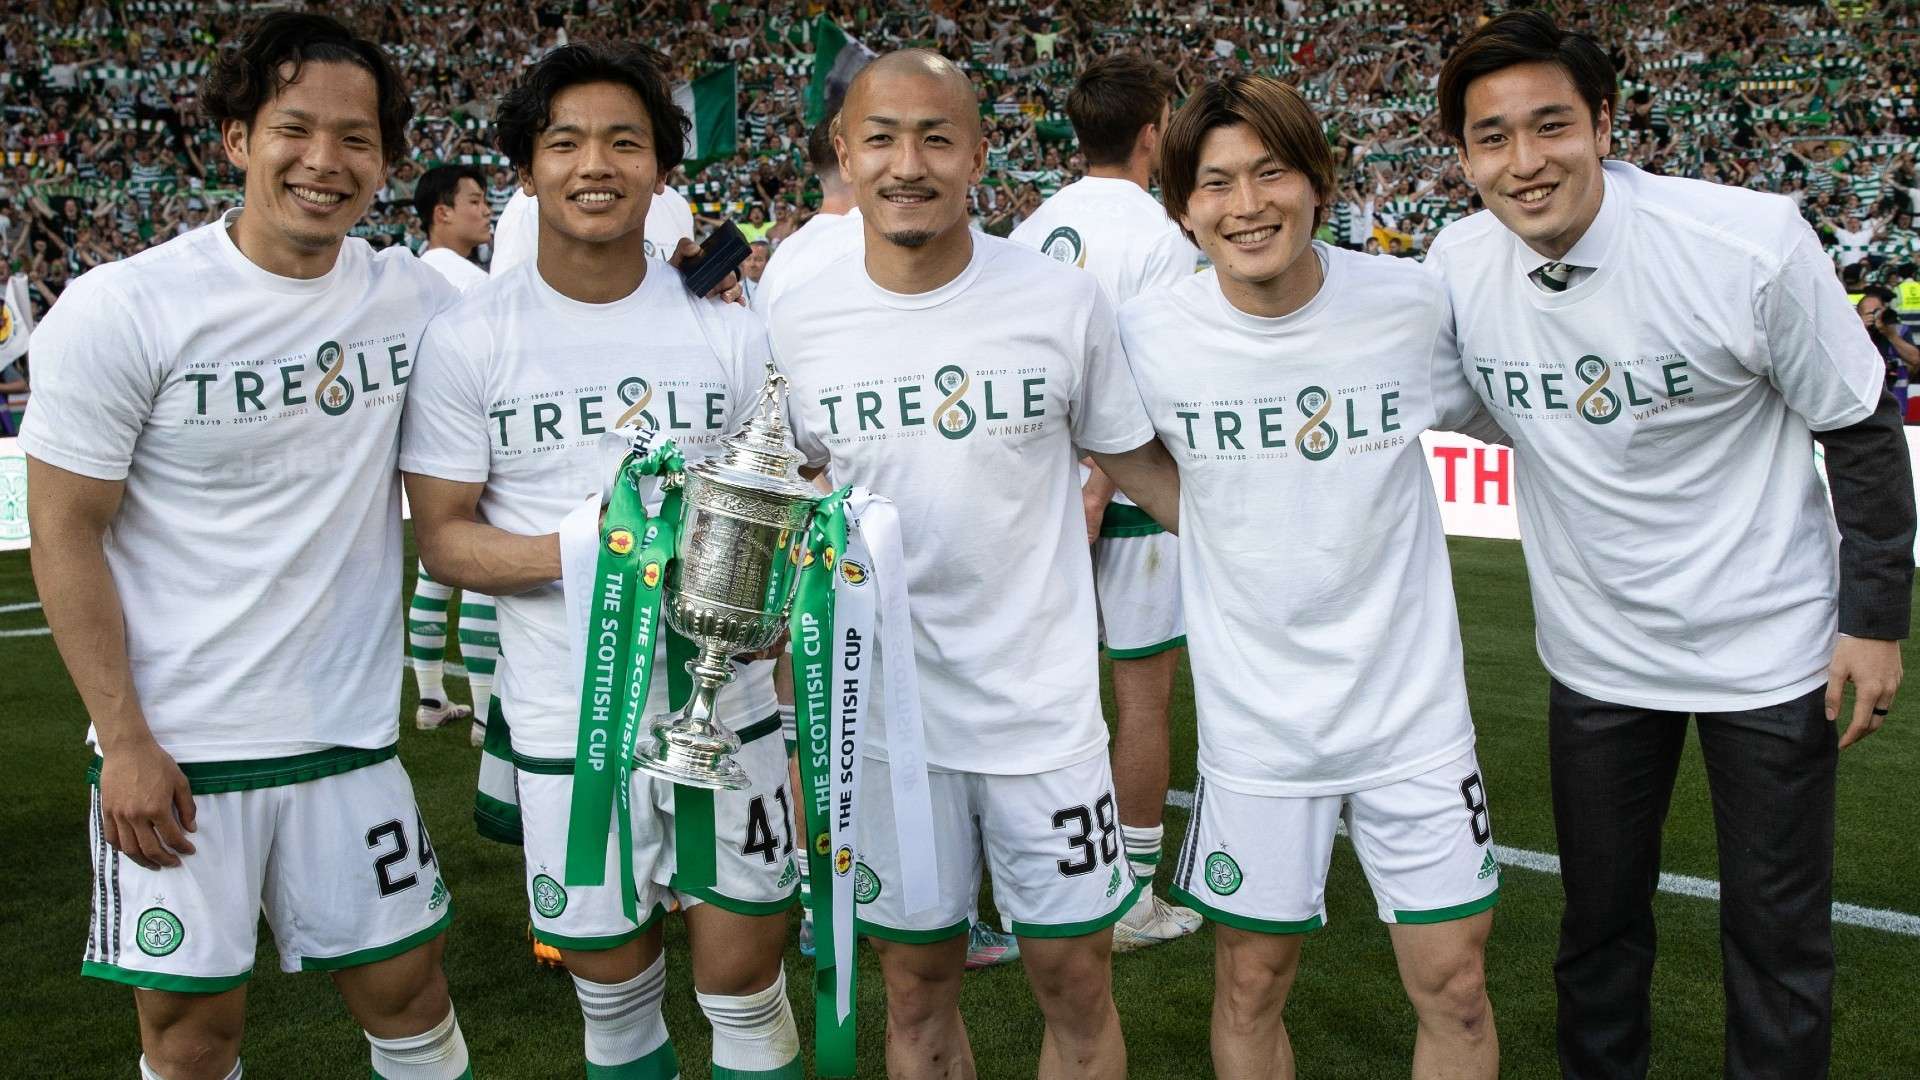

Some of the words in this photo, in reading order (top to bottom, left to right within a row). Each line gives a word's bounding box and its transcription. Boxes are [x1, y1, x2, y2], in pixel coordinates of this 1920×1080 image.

[1655, 353, 1684, 362] 2017/1
[987, 422, 1043, 437] WINNERS
[1348, 435, 1405, 455] WINNERS
[603, 573, 623, 612] THE
[638, 606, 652, 647] THE
[801, 612, 820, 656] CUP
[592, 618, 619, 721] SCOTTISH
[844, 628, 862, 671] CUP
[621, 653, 645, 760] SCOTTISH
[806, 663, 829, 768] SCOTTISH
[588, 728, 607, 771] CUP
[841, 679, 859, 784] SCOTTISH
[814, 774, 830, 816] THE
[839, 790, 852, 832] THE
[1459, 769, 1491, 848] 8
[741, 783, 794, 865] 41
[1051, 790, 1119, 878] 38
[365, 806, 438, 899] 24
